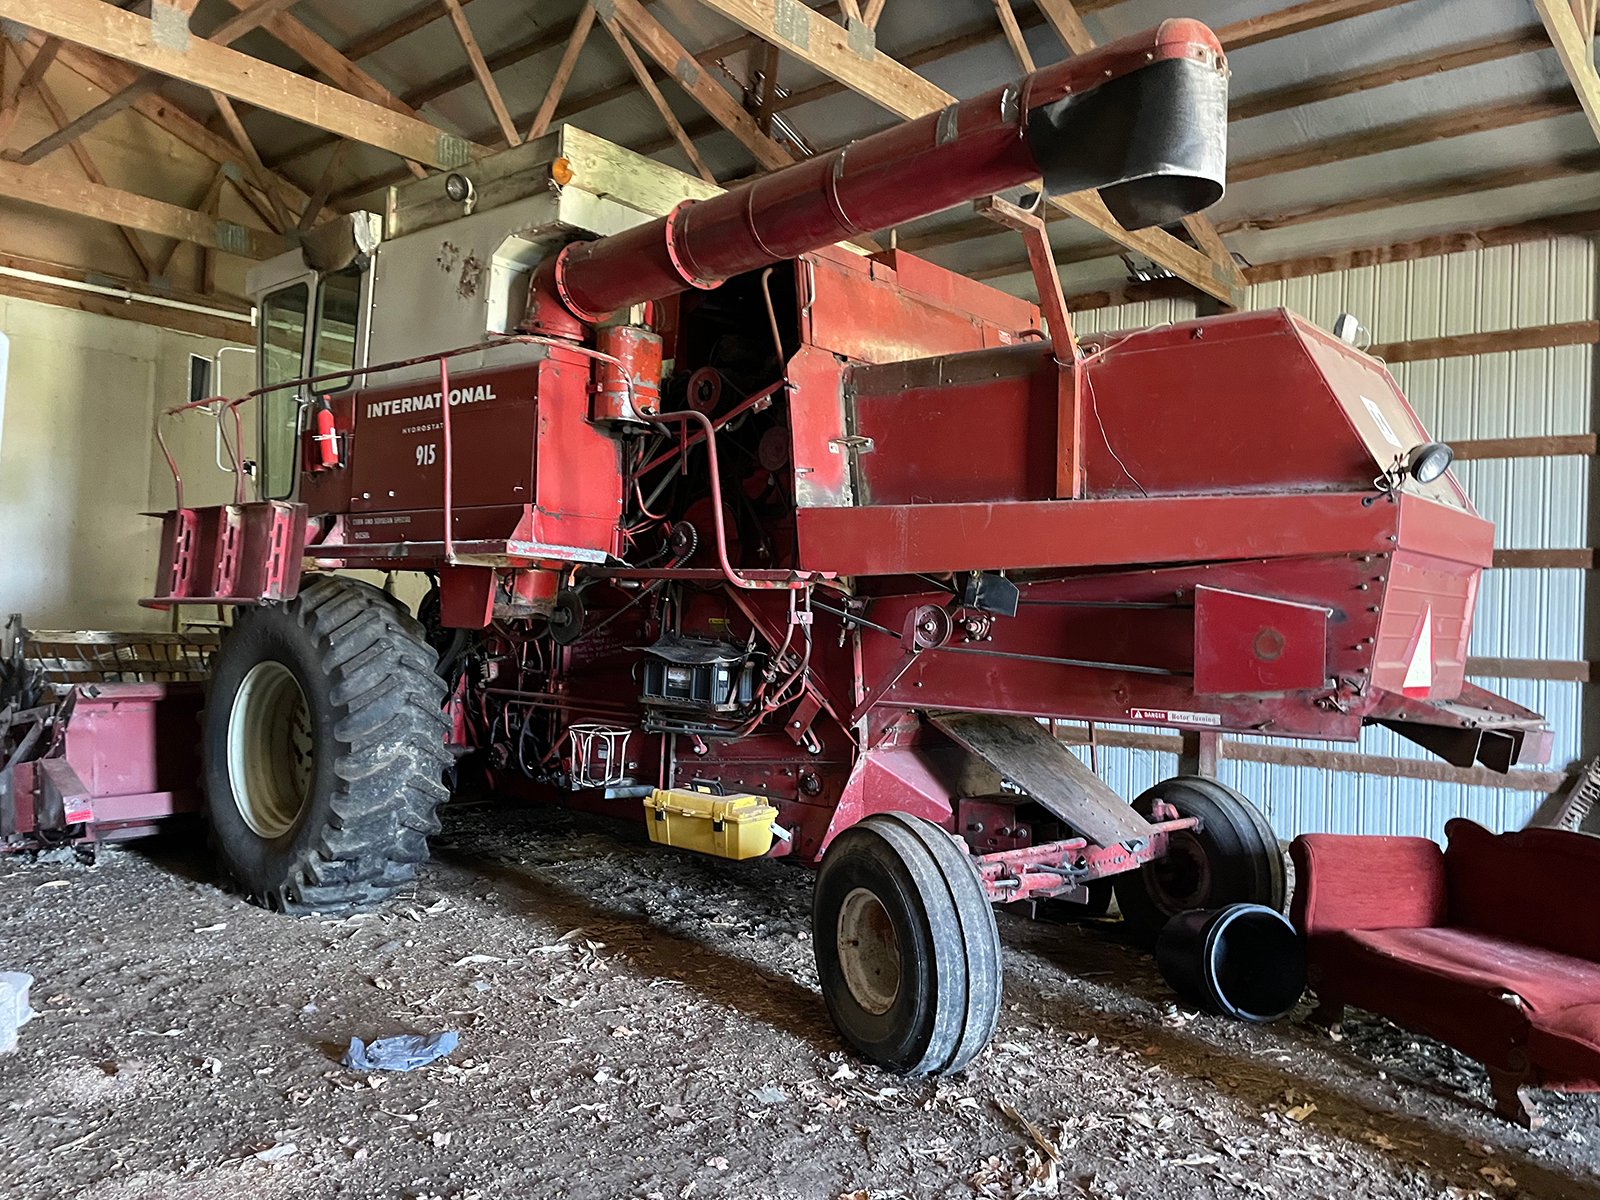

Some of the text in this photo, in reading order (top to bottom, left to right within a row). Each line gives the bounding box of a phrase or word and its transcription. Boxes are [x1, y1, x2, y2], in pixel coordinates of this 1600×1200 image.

[367, 384, 497, 418] INTERNATONAL
[401, 422, 446, 434] HYDROSTAT
[415, 444, 436, 466] 915
[1143, 711, 1216, 724] DANGER Motor Turning
